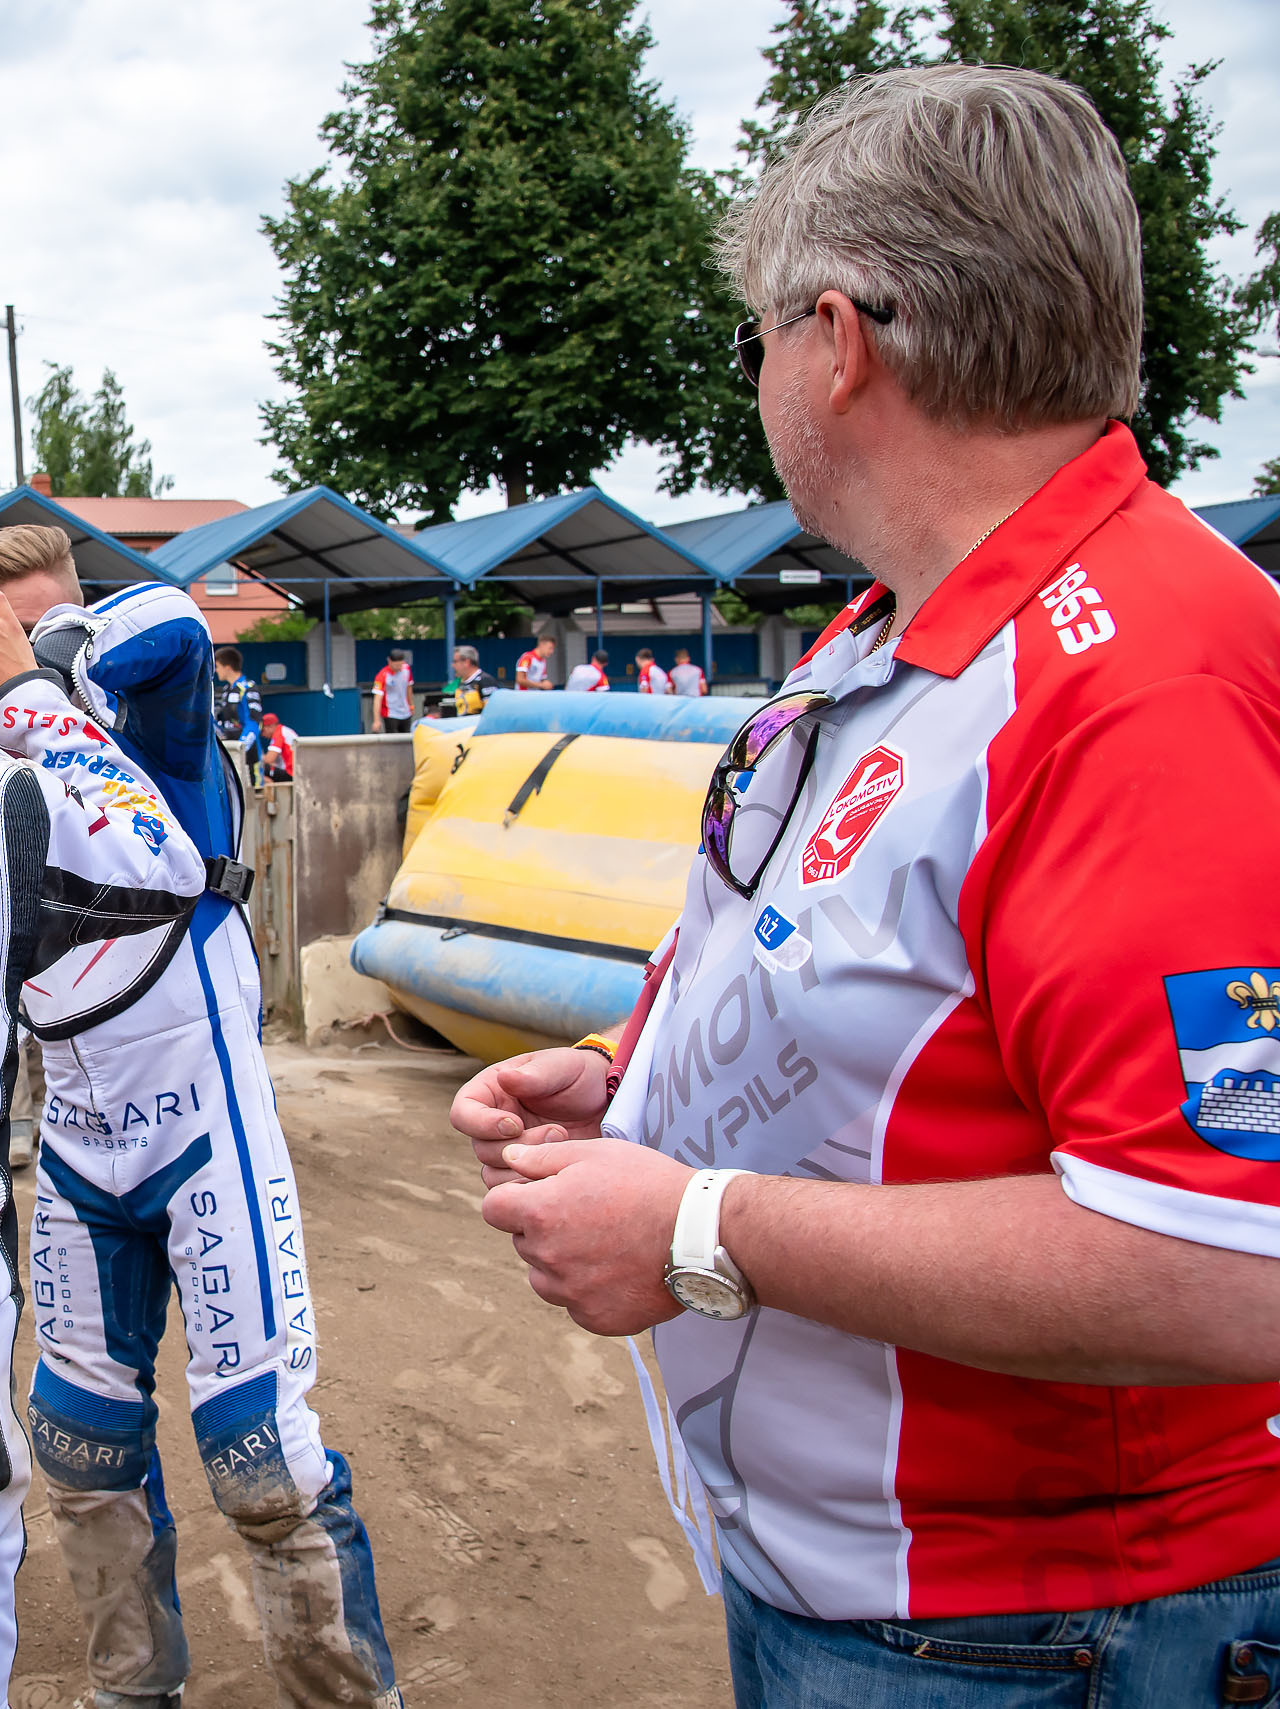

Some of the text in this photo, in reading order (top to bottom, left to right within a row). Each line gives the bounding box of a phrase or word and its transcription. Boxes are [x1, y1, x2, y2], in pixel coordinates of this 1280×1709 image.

[1038, 562, 1117, 655] 1963
[829, 774, 898, 818] LOKOMOTIV
[47, 1082, 201, 1136] SAGARI
[82, 1136, 148, 1149] SPORTS
[57, 1247, 74, 1329] SPORTS
[185, 1246, 203, 1333] SPORTS
[269, 1177, 312, 1370] SAGARI
[28, 1406, 123, 1467] SAGARI
